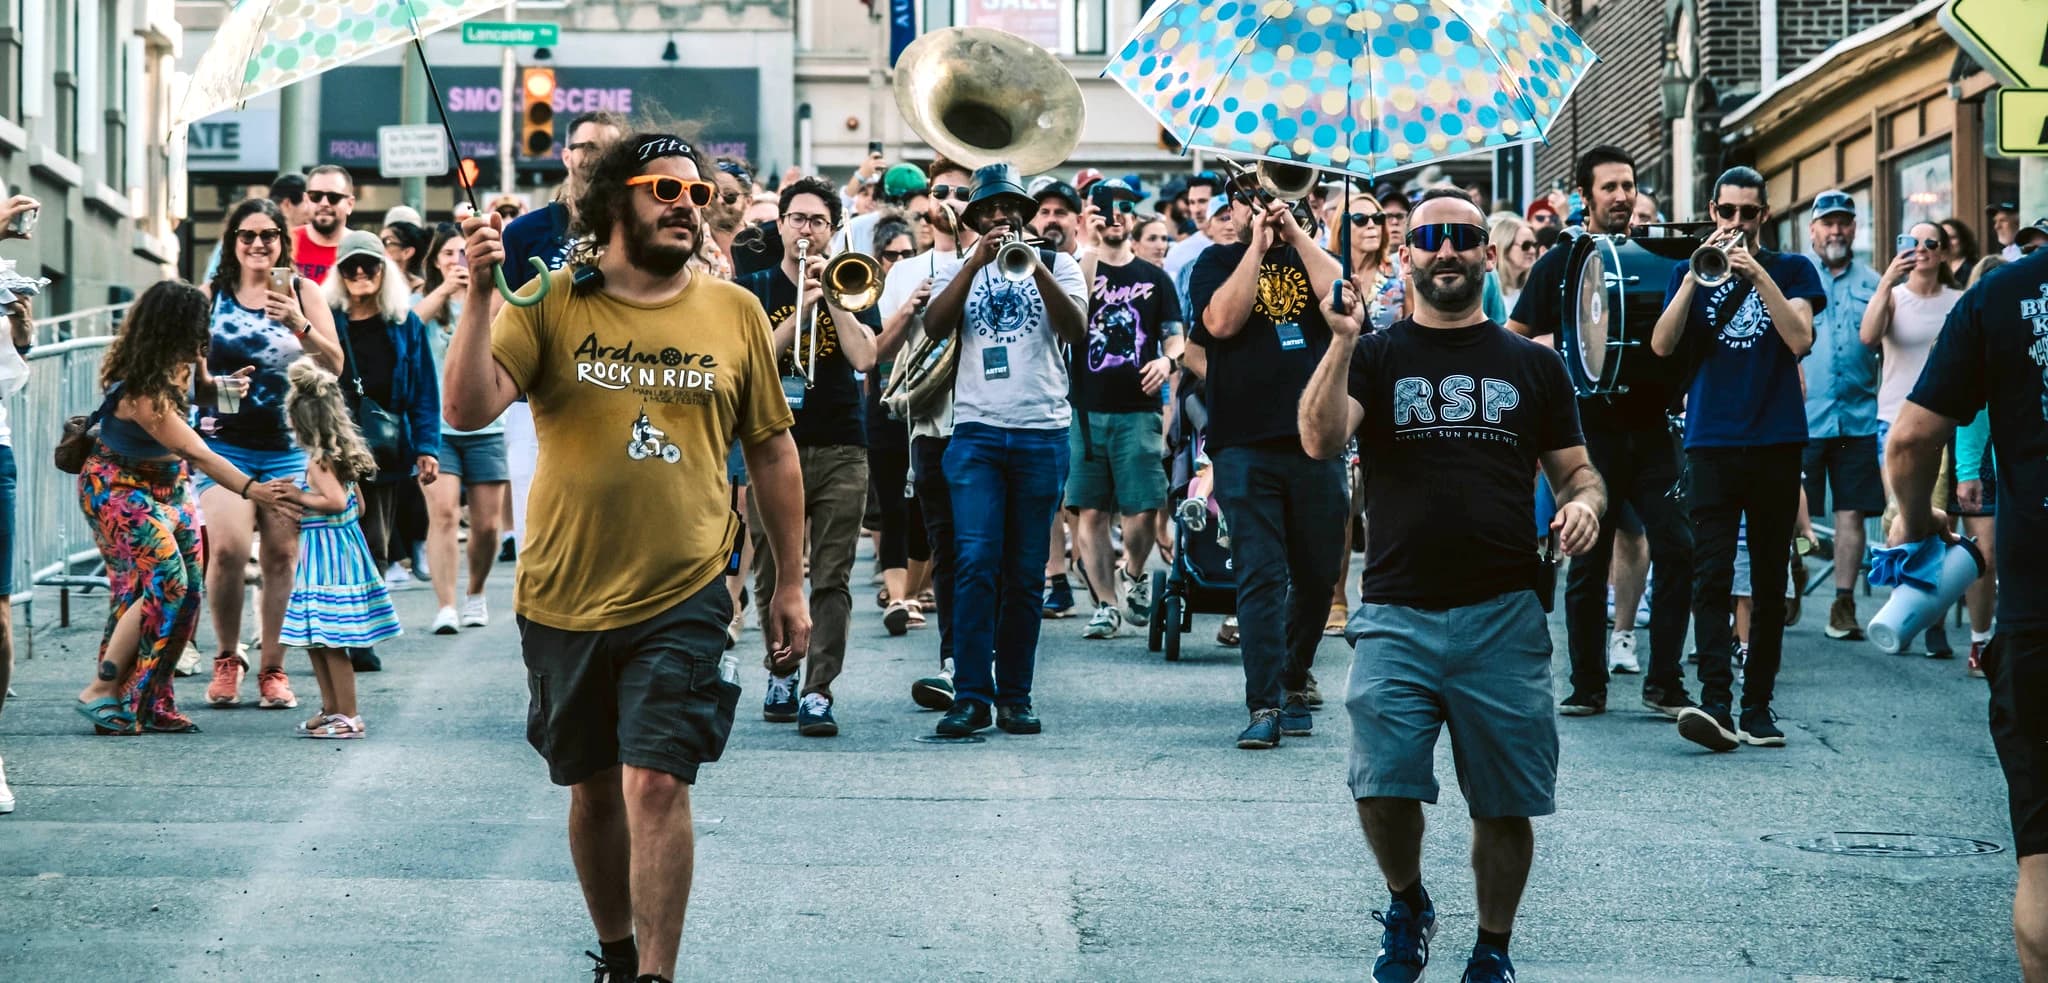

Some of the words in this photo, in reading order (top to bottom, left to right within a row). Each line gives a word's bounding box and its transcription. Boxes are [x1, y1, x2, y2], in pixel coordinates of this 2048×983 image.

[466, 26, 535, 42] Lancaster
[552, 88, 632, 112] SCENE
[1093, 274, 1155, 304] Prince
[574, 332, 719, 369] Ardmore
[577, 361, 634, 390] ROCK
[638, 368, 656, 387] N
[662, 368, 716, 392] RIDE
[985, 366, 1008, 375] ARTIST
[1393, 374, 1520, 426] RSP
[1439, 430, 1461, 438] SUN
[1467, 431, 1520, 447] PRESENTS
